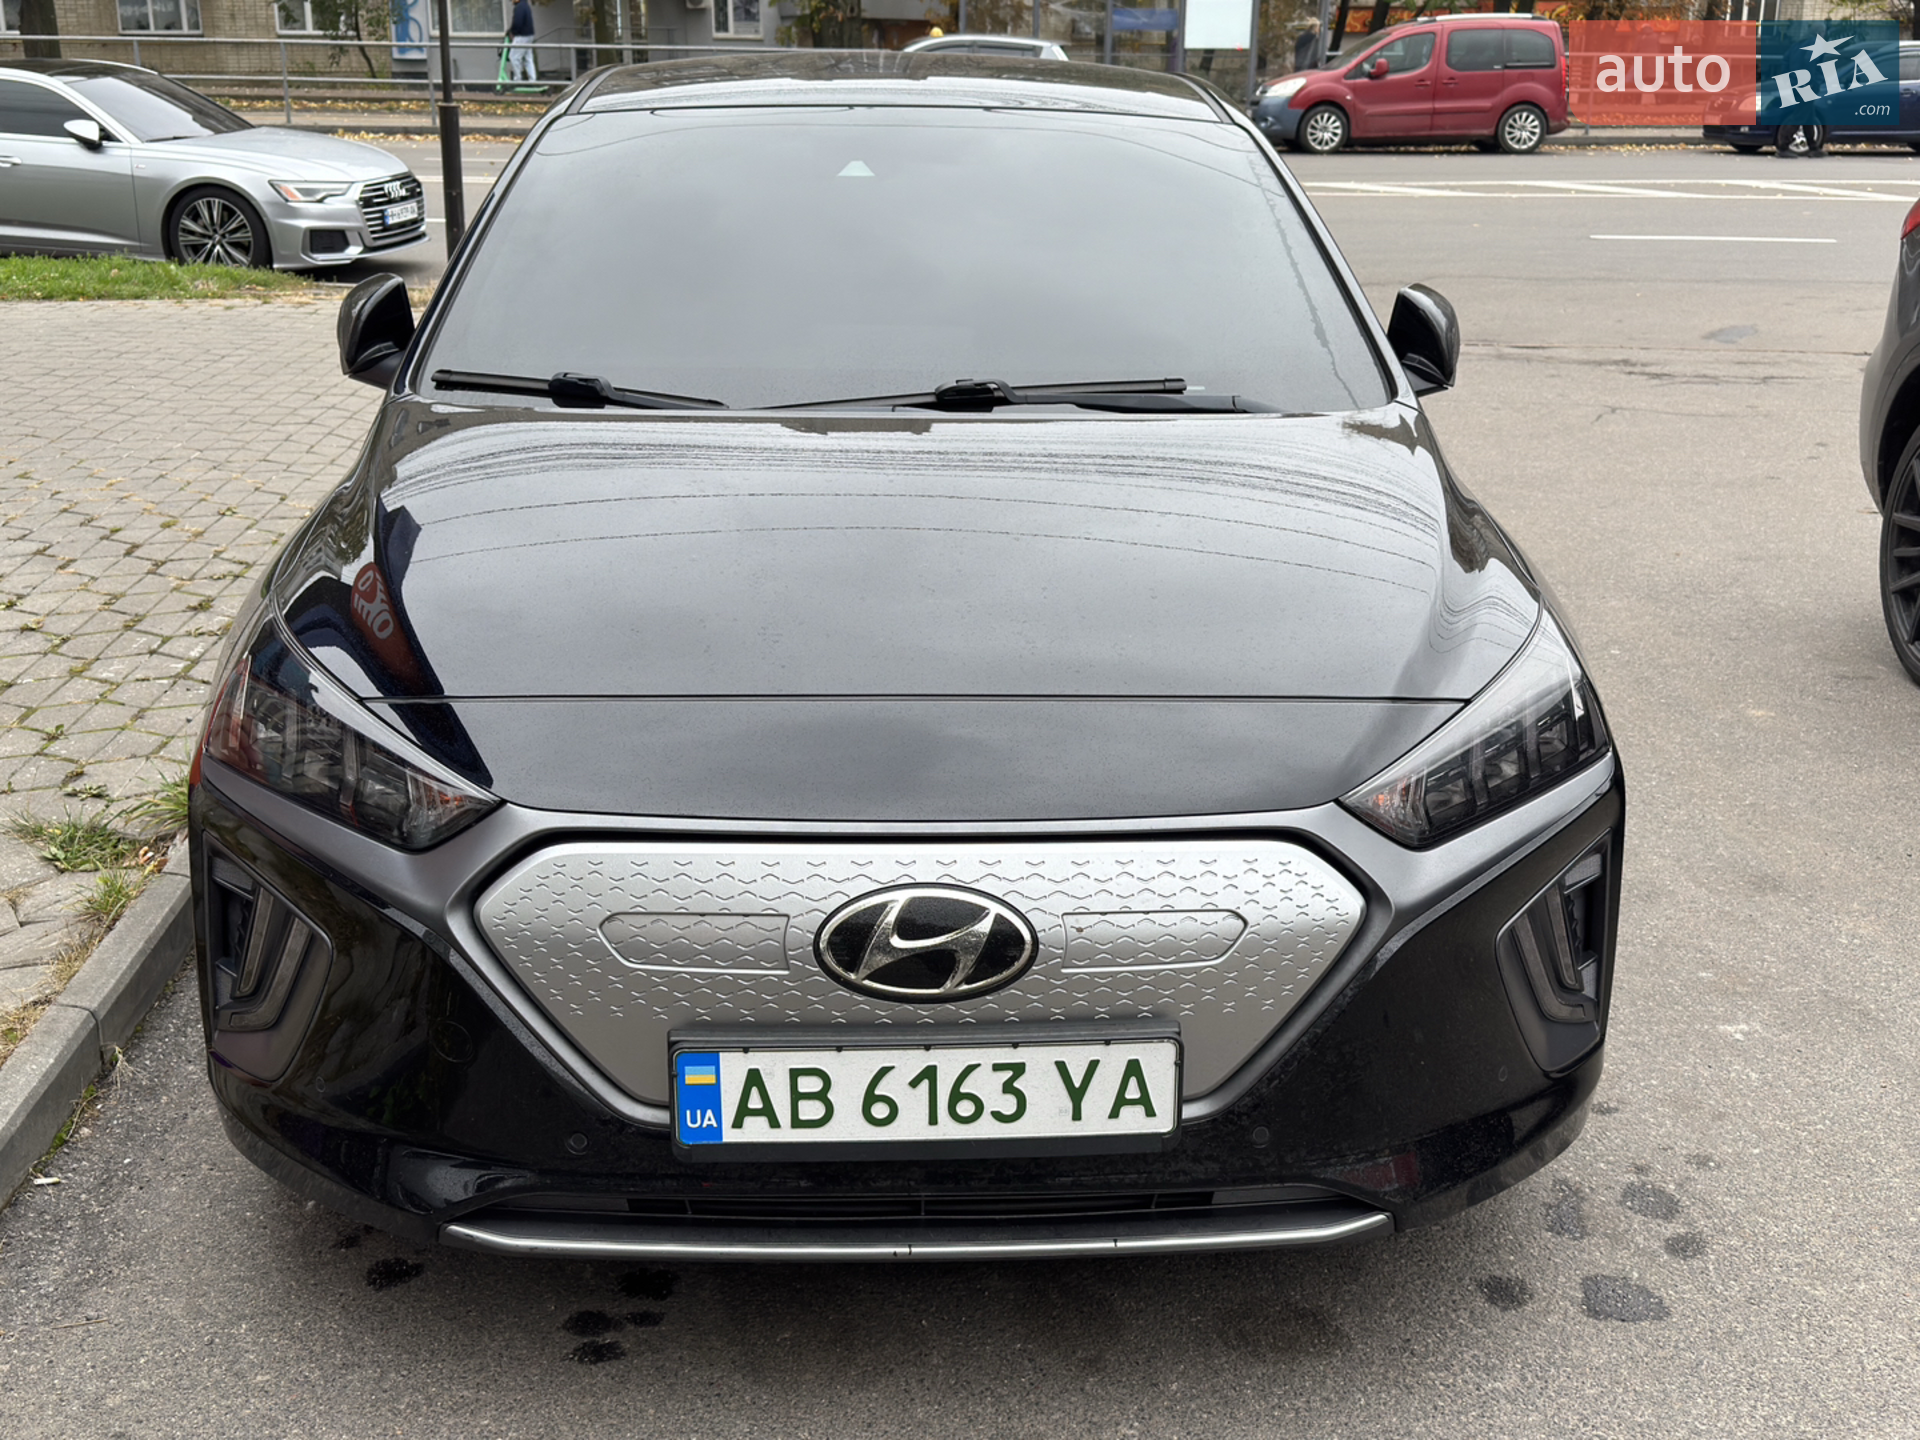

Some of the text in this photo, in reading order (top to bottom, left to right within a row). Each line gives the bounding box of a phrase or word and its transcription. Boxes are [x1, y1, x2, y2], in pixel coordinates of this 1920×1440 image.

[730, 1058, 1158, 1130] AB 6163 YA
[685, 1109, 718, 1129] UA
